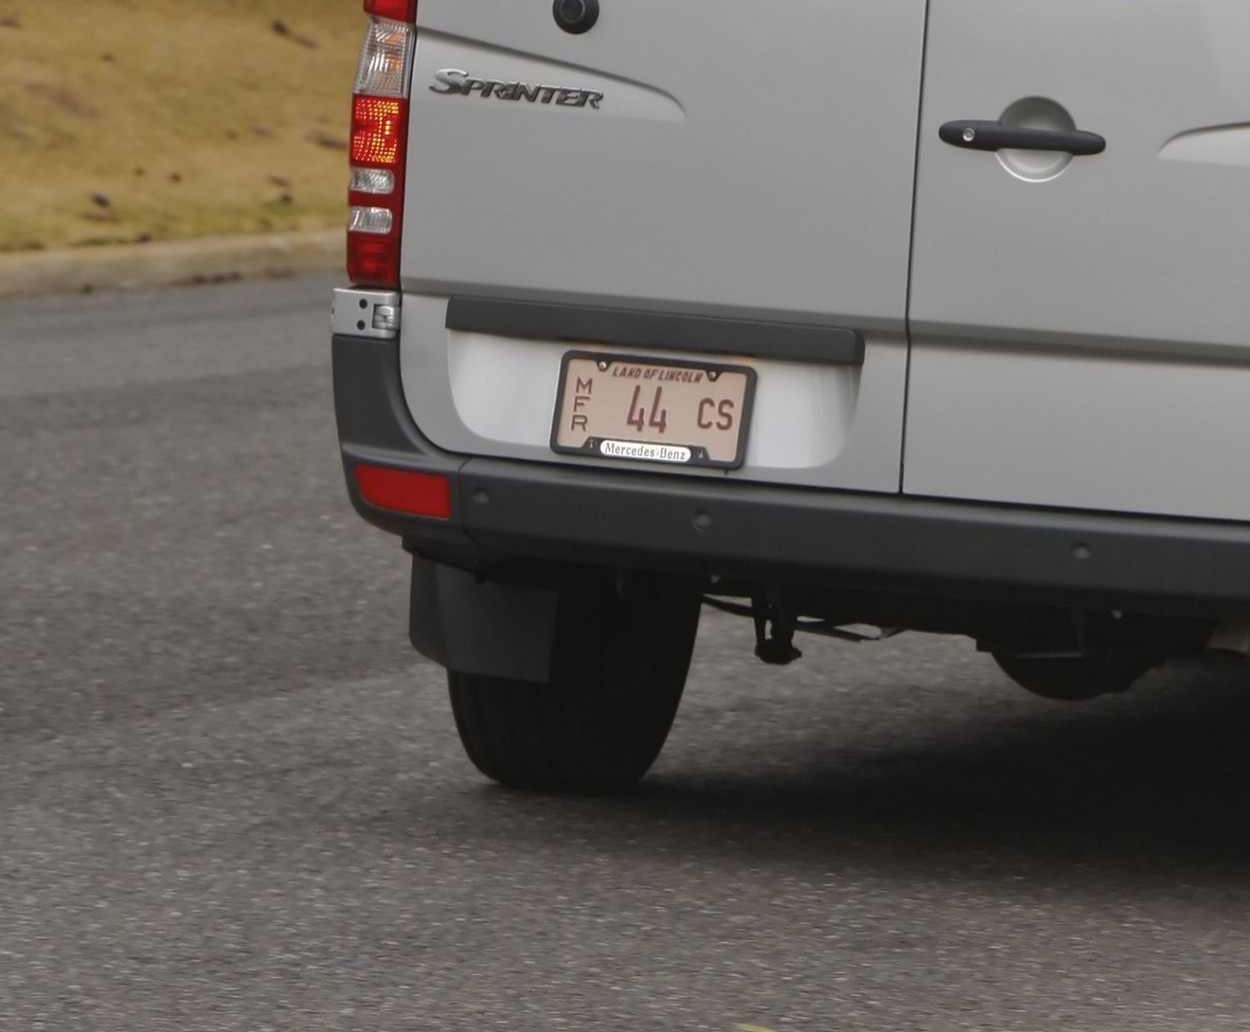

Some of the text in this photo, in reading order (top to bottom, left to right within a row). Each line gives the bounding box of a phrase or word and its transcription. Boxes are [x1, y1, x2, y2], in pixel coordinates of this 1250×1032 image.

[429, 68, 604, 109] SPRINTER
[612, 367, 704, 383] LAND OF LINCOLN
[626, 384, 735, 434] 44 CS
